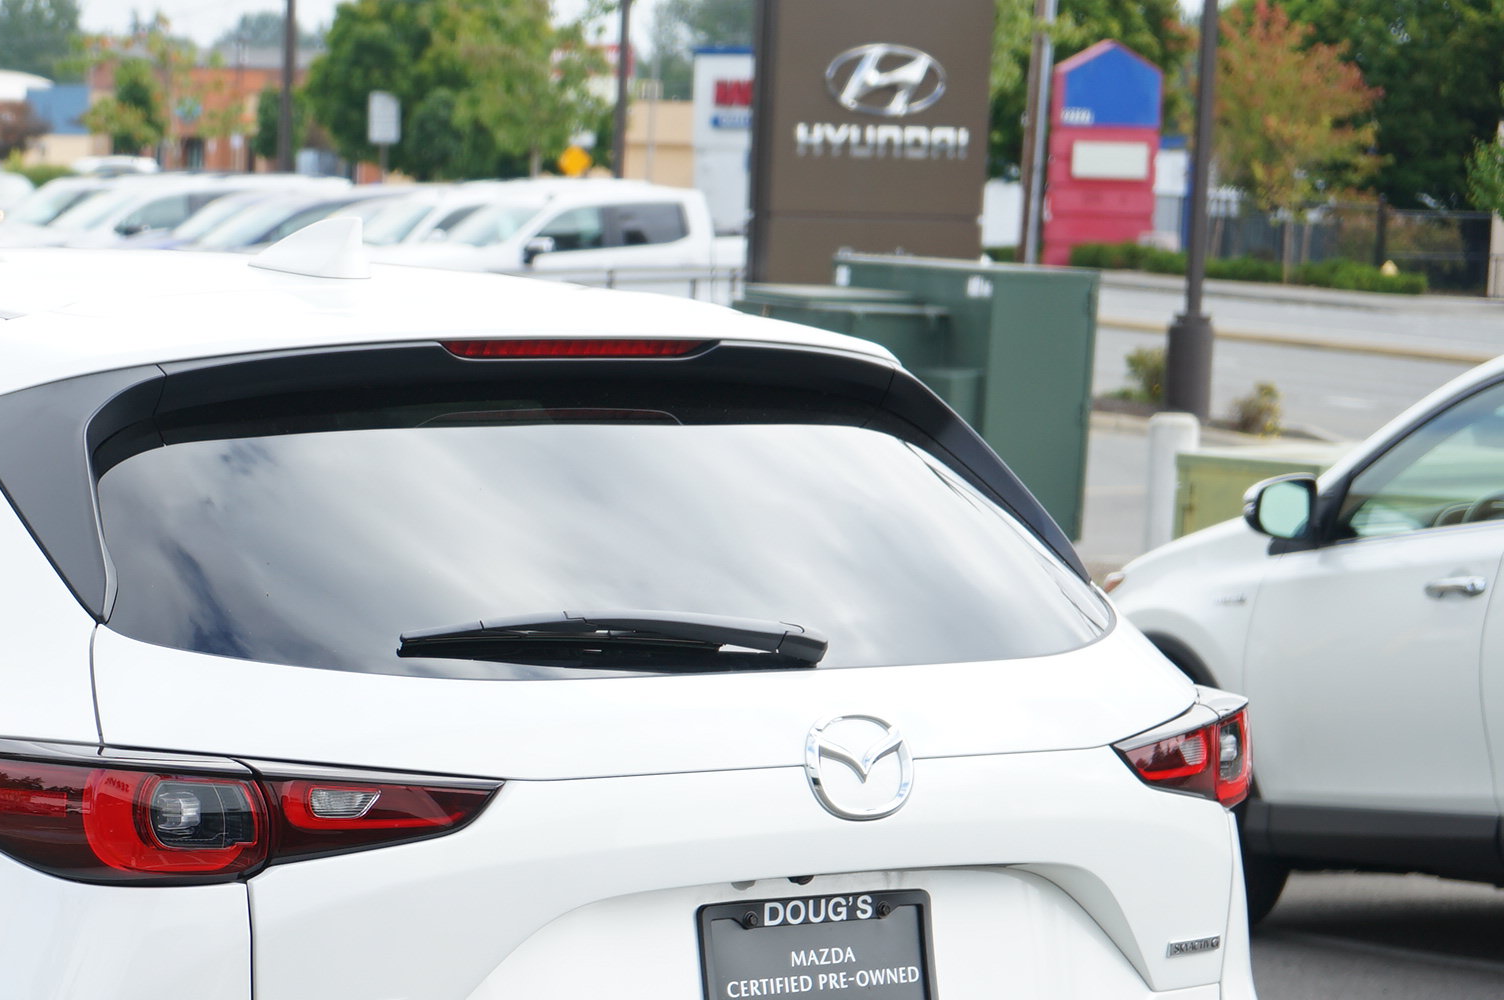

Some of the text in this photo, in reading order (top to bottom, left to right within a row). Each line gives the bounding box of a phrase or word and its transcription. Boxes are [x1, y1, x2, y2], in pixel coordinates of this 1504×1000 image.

[795, 122, 969, 159] HYUNDAI
[763, 895, 873, 926] DOUG'S
[791, 946, 856, 967] MAZDA
[727, 966, 920, 998] CERTIFIED PRE-OWNED
